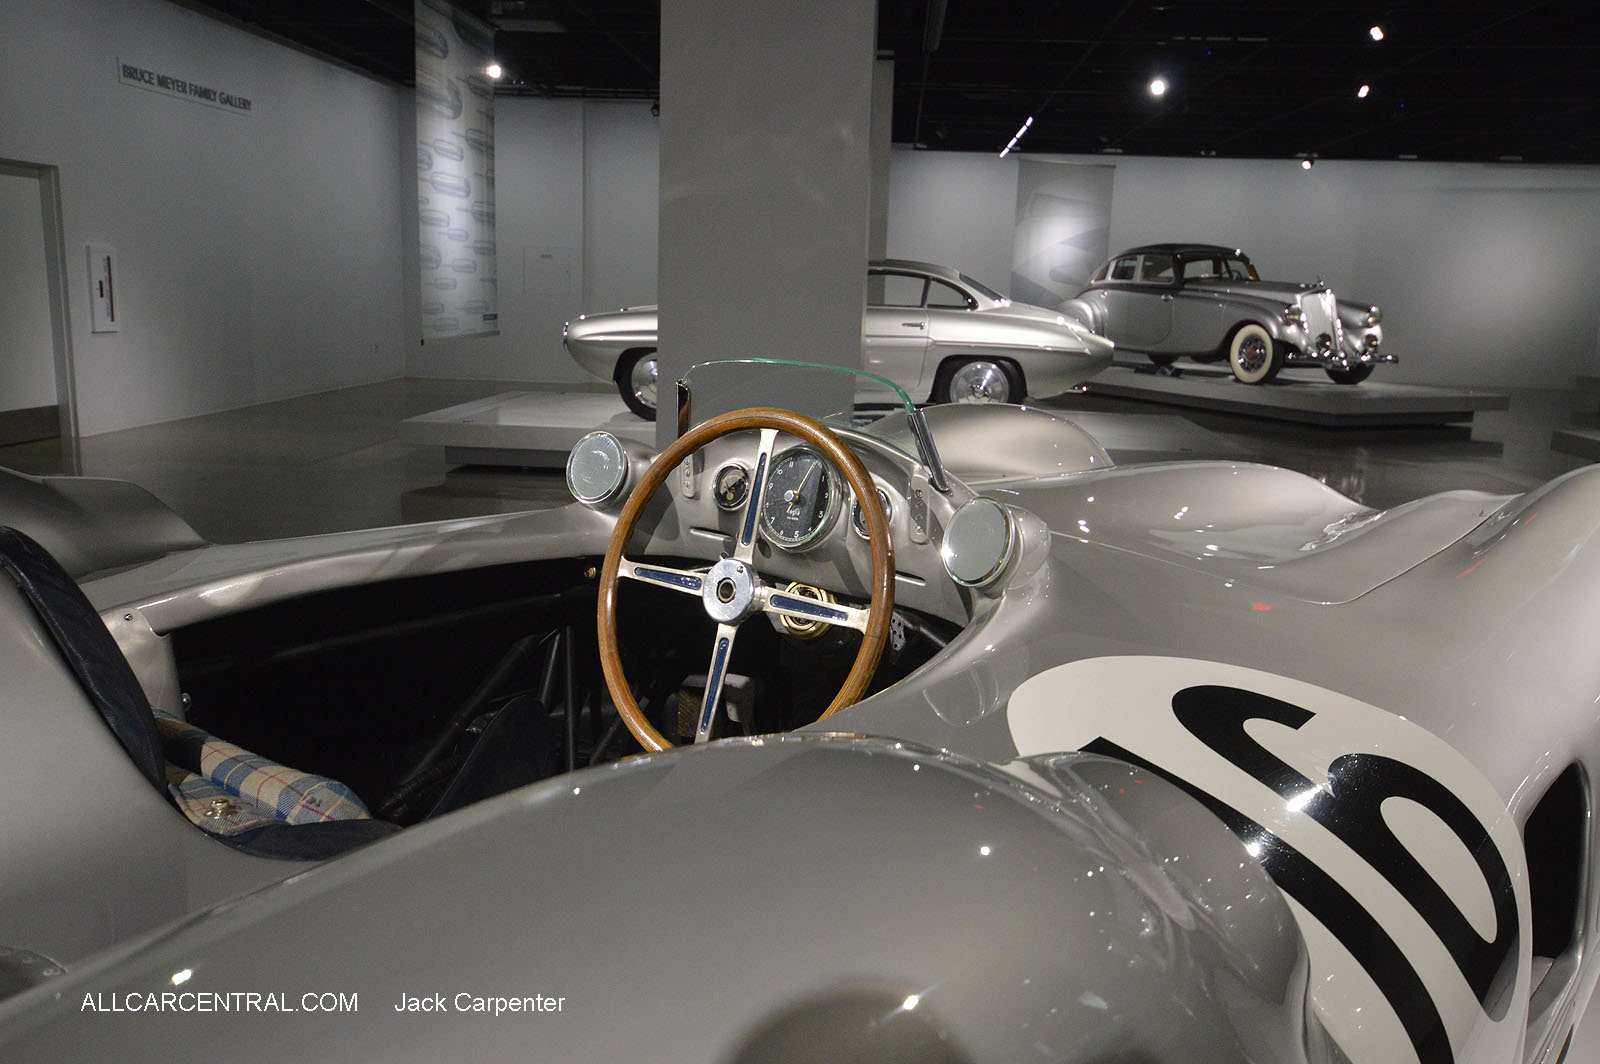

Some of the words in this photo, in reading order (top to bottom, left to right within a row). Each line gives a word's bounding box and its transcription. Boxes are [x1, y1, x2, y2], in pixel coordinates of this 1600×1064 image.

[122, 64, 154, 85] BRUCE
[157, 74, 187, 94] MEYER
[189, 83, 217, 101] FAMILY
[219, 92, 252, 110] GALLERY
[818, 510, 824, 519] 3
[770, 516, 776, 525] 7
[793, 530, 800, 538] 5
